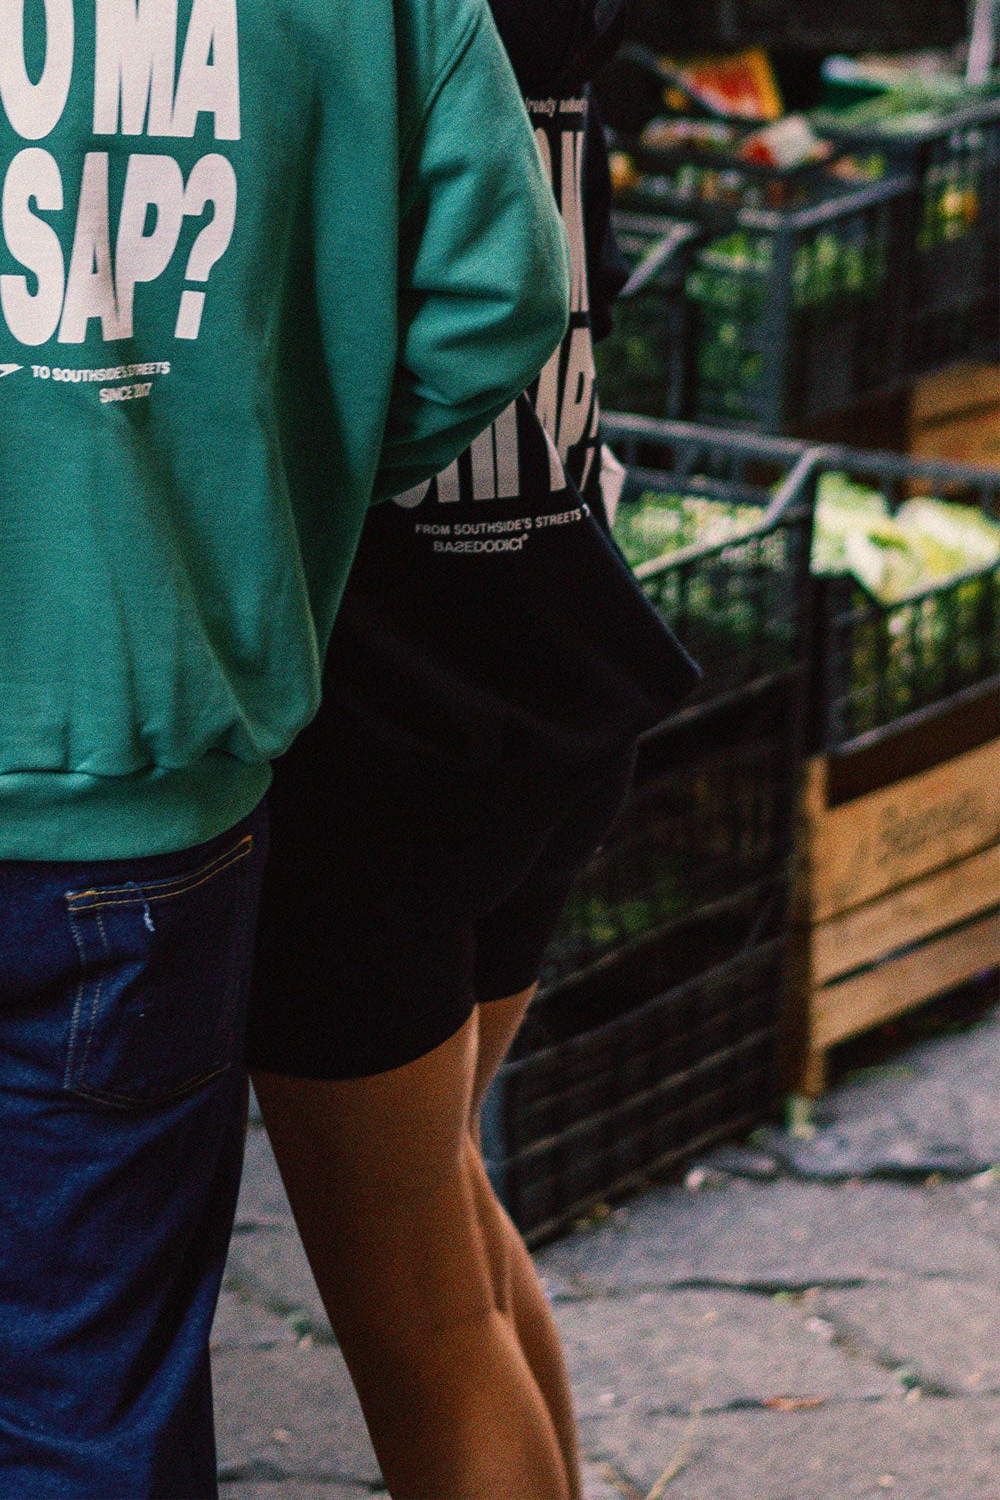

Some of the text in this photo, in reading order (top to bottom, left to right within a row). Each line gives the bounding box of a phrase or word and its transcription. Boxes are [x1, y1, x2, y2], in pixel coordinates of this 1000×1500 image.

[0, 147, 238, 347] SAP?
[31, 365, 51, 379] TO
[415, 508, 582, 536] FROM SOUTHSIDE'S STREETS
